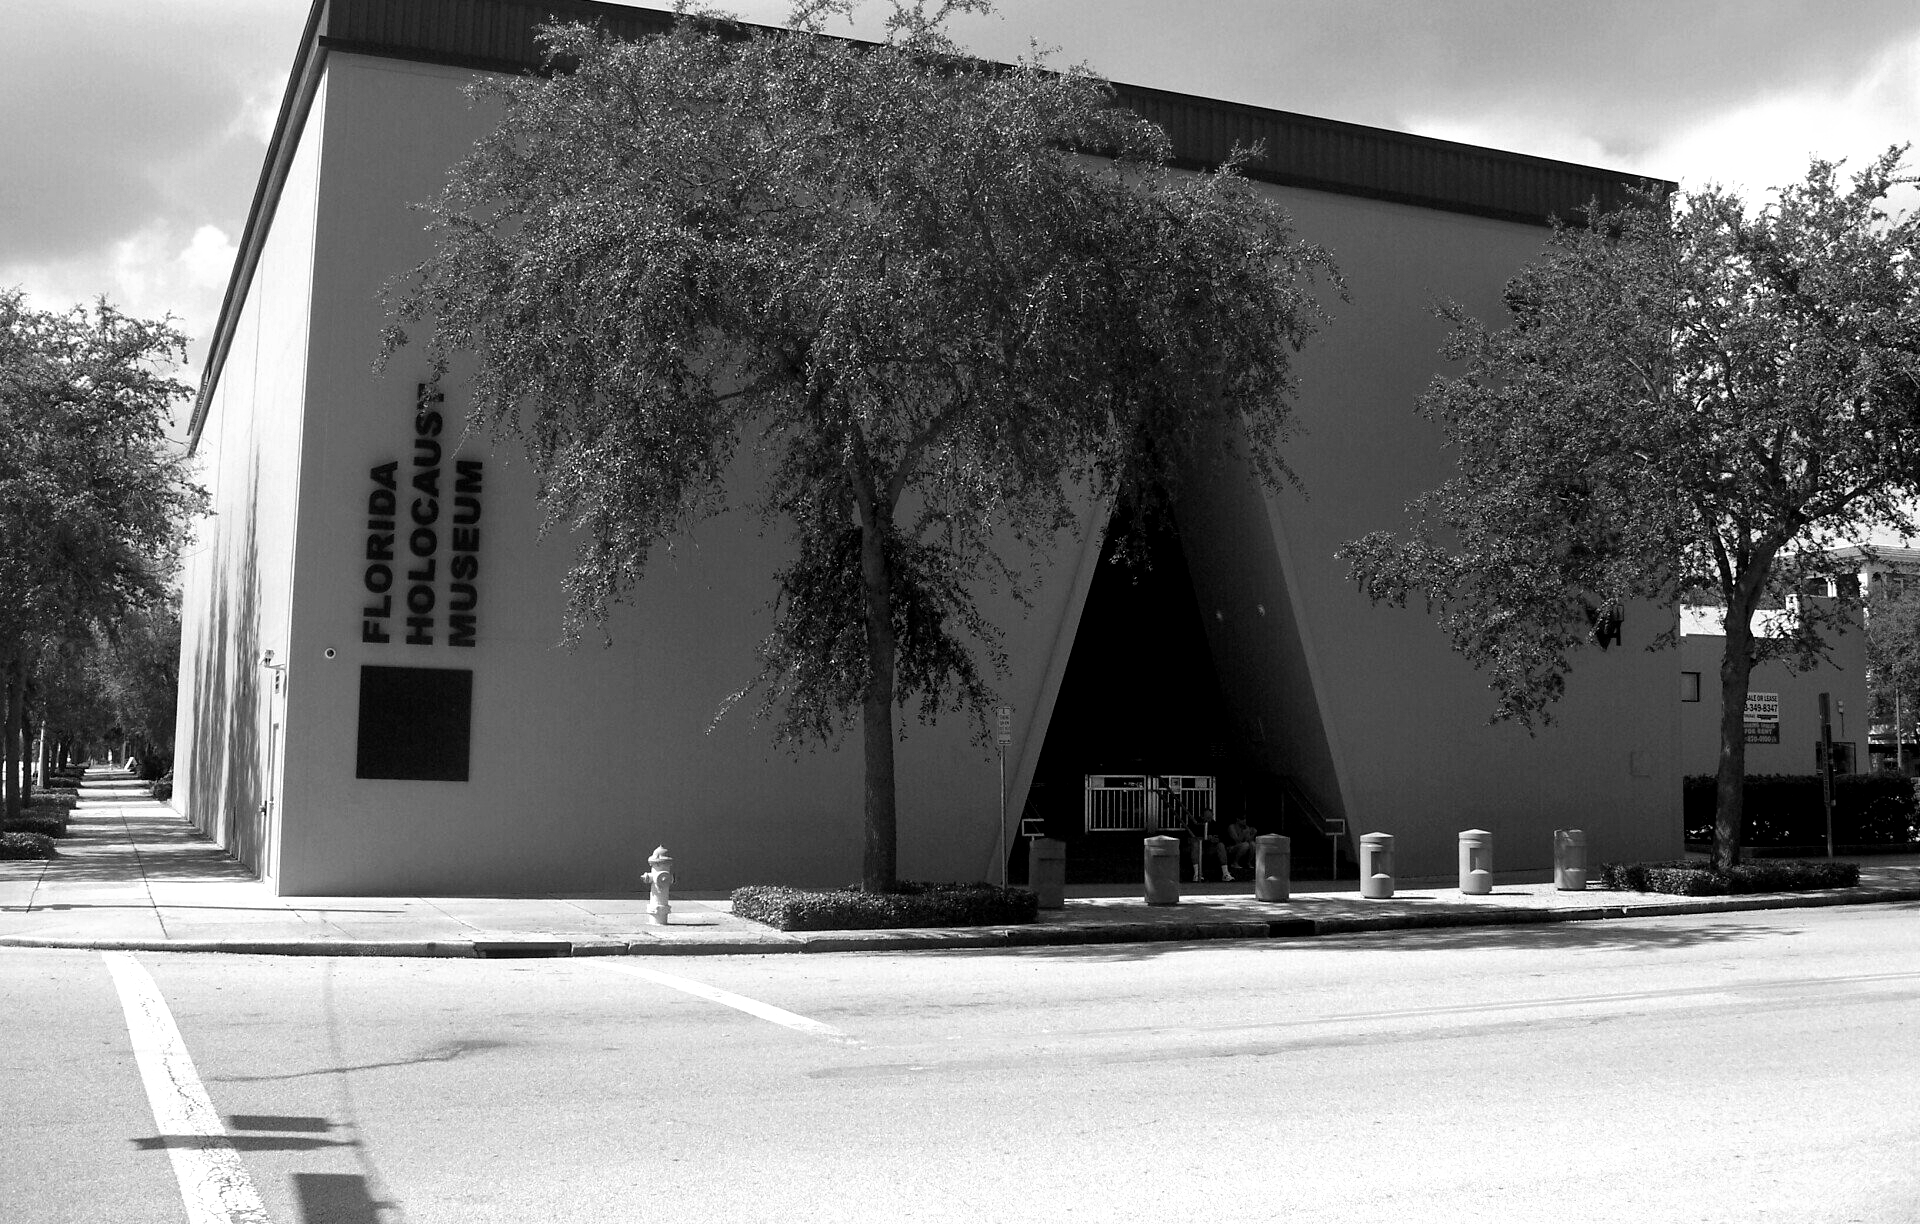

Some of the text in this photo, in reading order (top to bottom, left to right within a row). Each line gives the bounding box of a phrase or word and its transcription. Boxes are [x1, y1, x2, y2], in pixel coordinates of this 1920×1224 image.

[362, 461, 398, 643] FLORIDA
[406, 383, 444, 645] HOLOCAUST
[448, 460, 483, 647] MUSEUM
